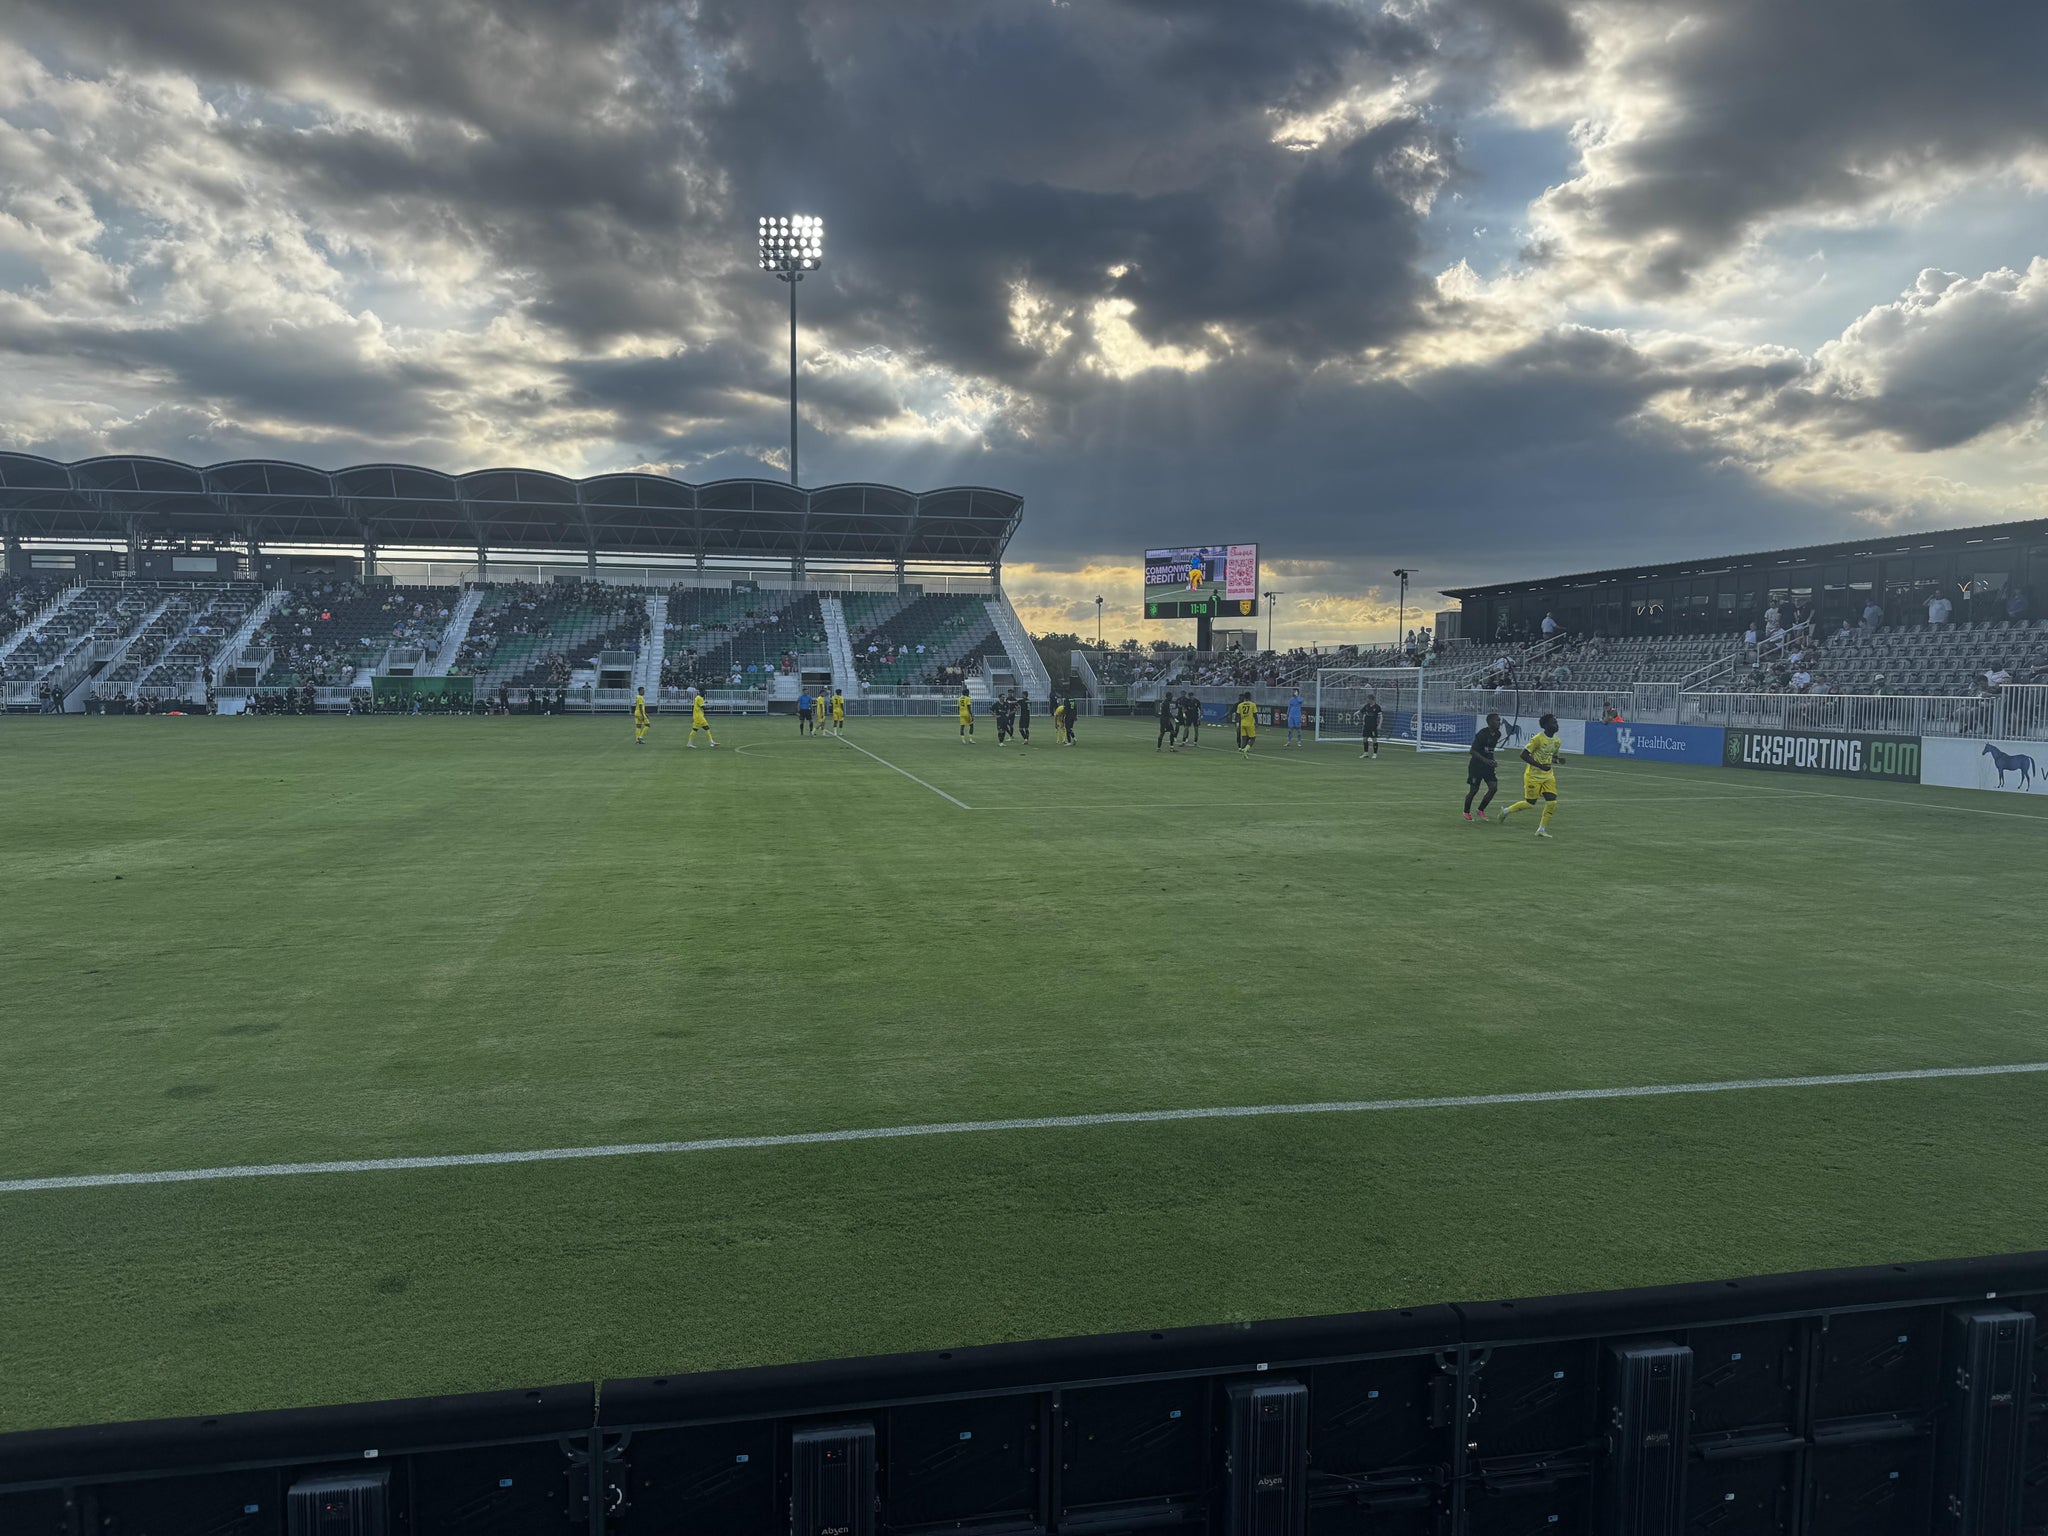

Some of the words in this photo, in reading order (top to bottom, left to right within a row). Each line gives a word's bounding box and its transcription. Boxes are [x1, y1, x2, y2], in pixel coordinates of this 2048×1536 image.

[1145, 563, 1206, 575] COMMONWETH
[1145, 573, 1175, 584] CREDIT
[1177, 571, 1206, 582] UNN
[1242, 706, 1250, 714] 27
[1437, 723, 1456, 733] PEPSI
[1616, 727, 1635, 754] UK
[1637, 735, 1686, 751] HealthCare
[1257, 1477, 1283, 1486] Absen
[821, 1526, 849, 1536] Absen
